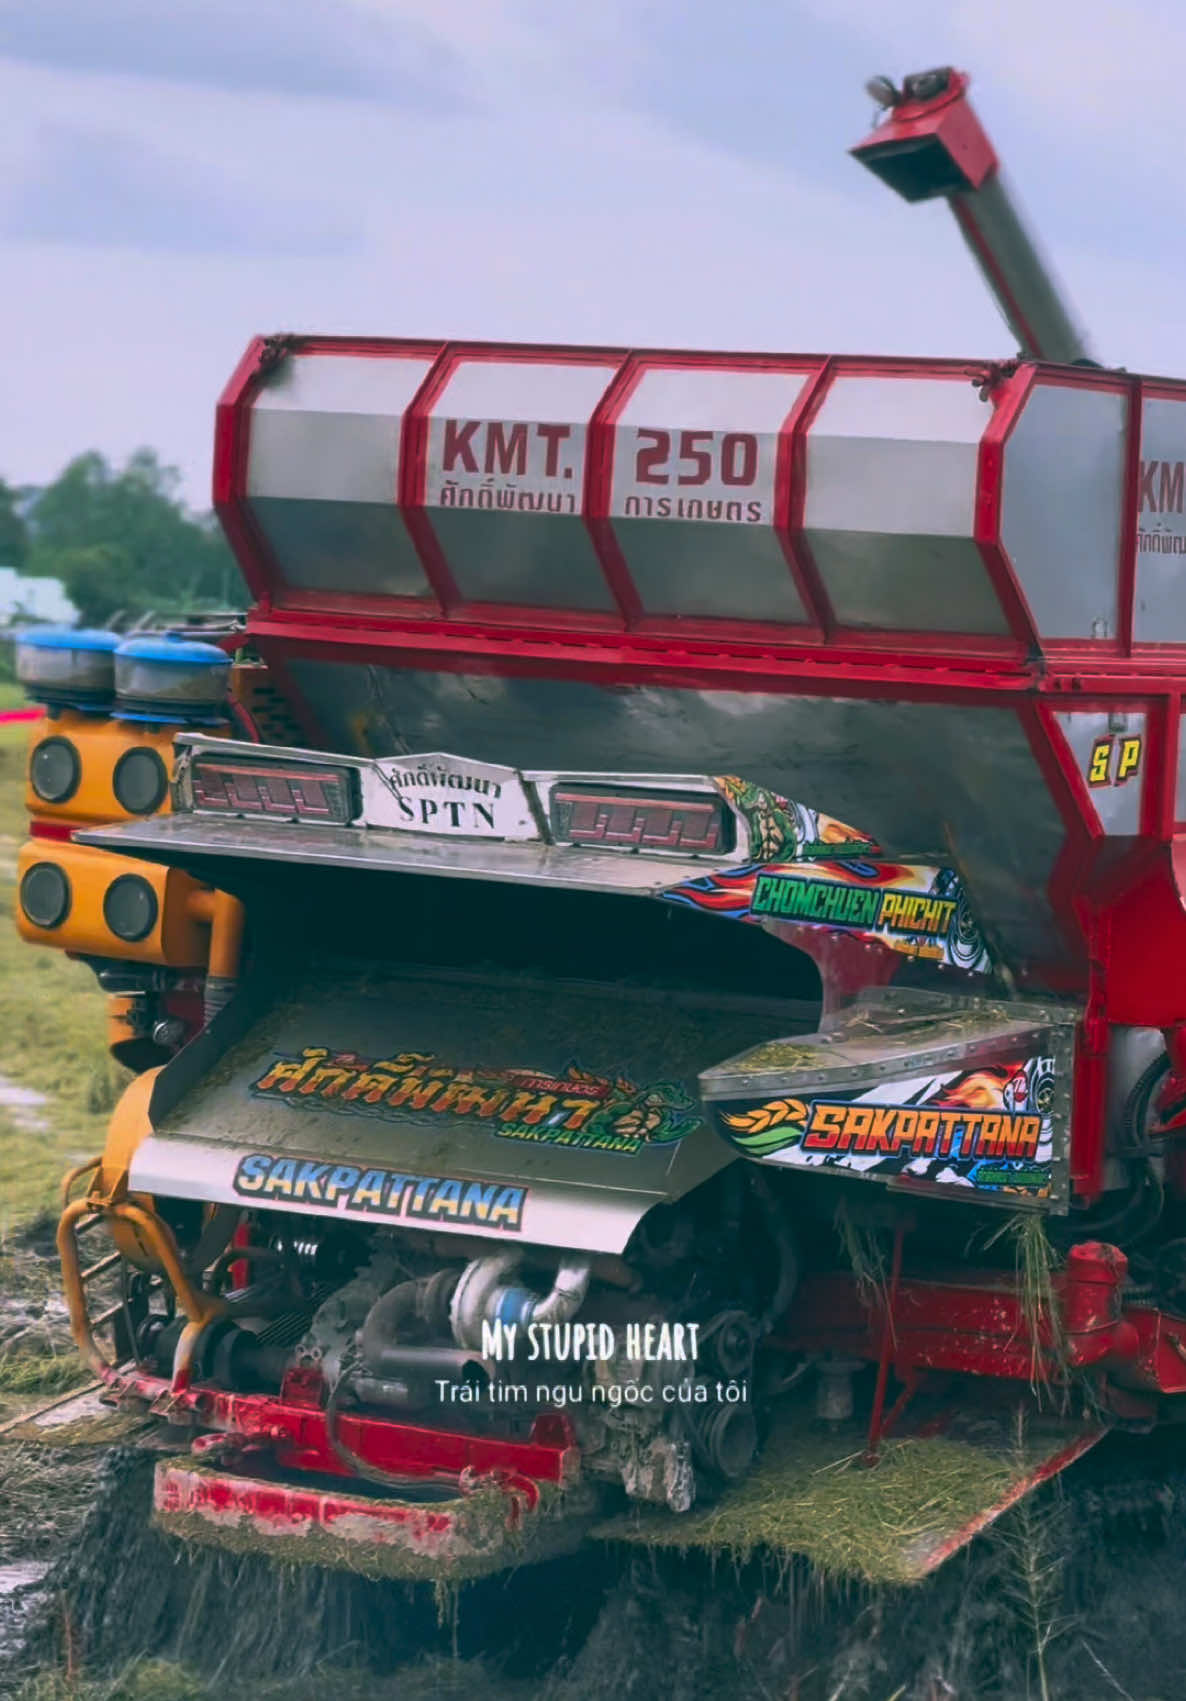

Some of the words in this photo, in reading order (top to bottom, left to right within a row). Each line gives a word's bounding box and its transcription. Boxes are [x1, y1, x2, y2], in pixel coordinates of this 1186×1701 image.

[442, 419, 573, 478] KMT.
[635, 428, 758, 486] 250
[624, 495, 763, 523] การเกษตร
[399, 796, 496, 829] SPTN
[752, 875, 878, 925] CHOMCHUEN
[877, 892, 957, 932] PHICHIT
[497, 1121, 644, 1154] SAKPATTANA
[803, 1103, 1041, 1160] SAKPATTANA
[236, 1154, 525, 1228] SAKPATTANA
